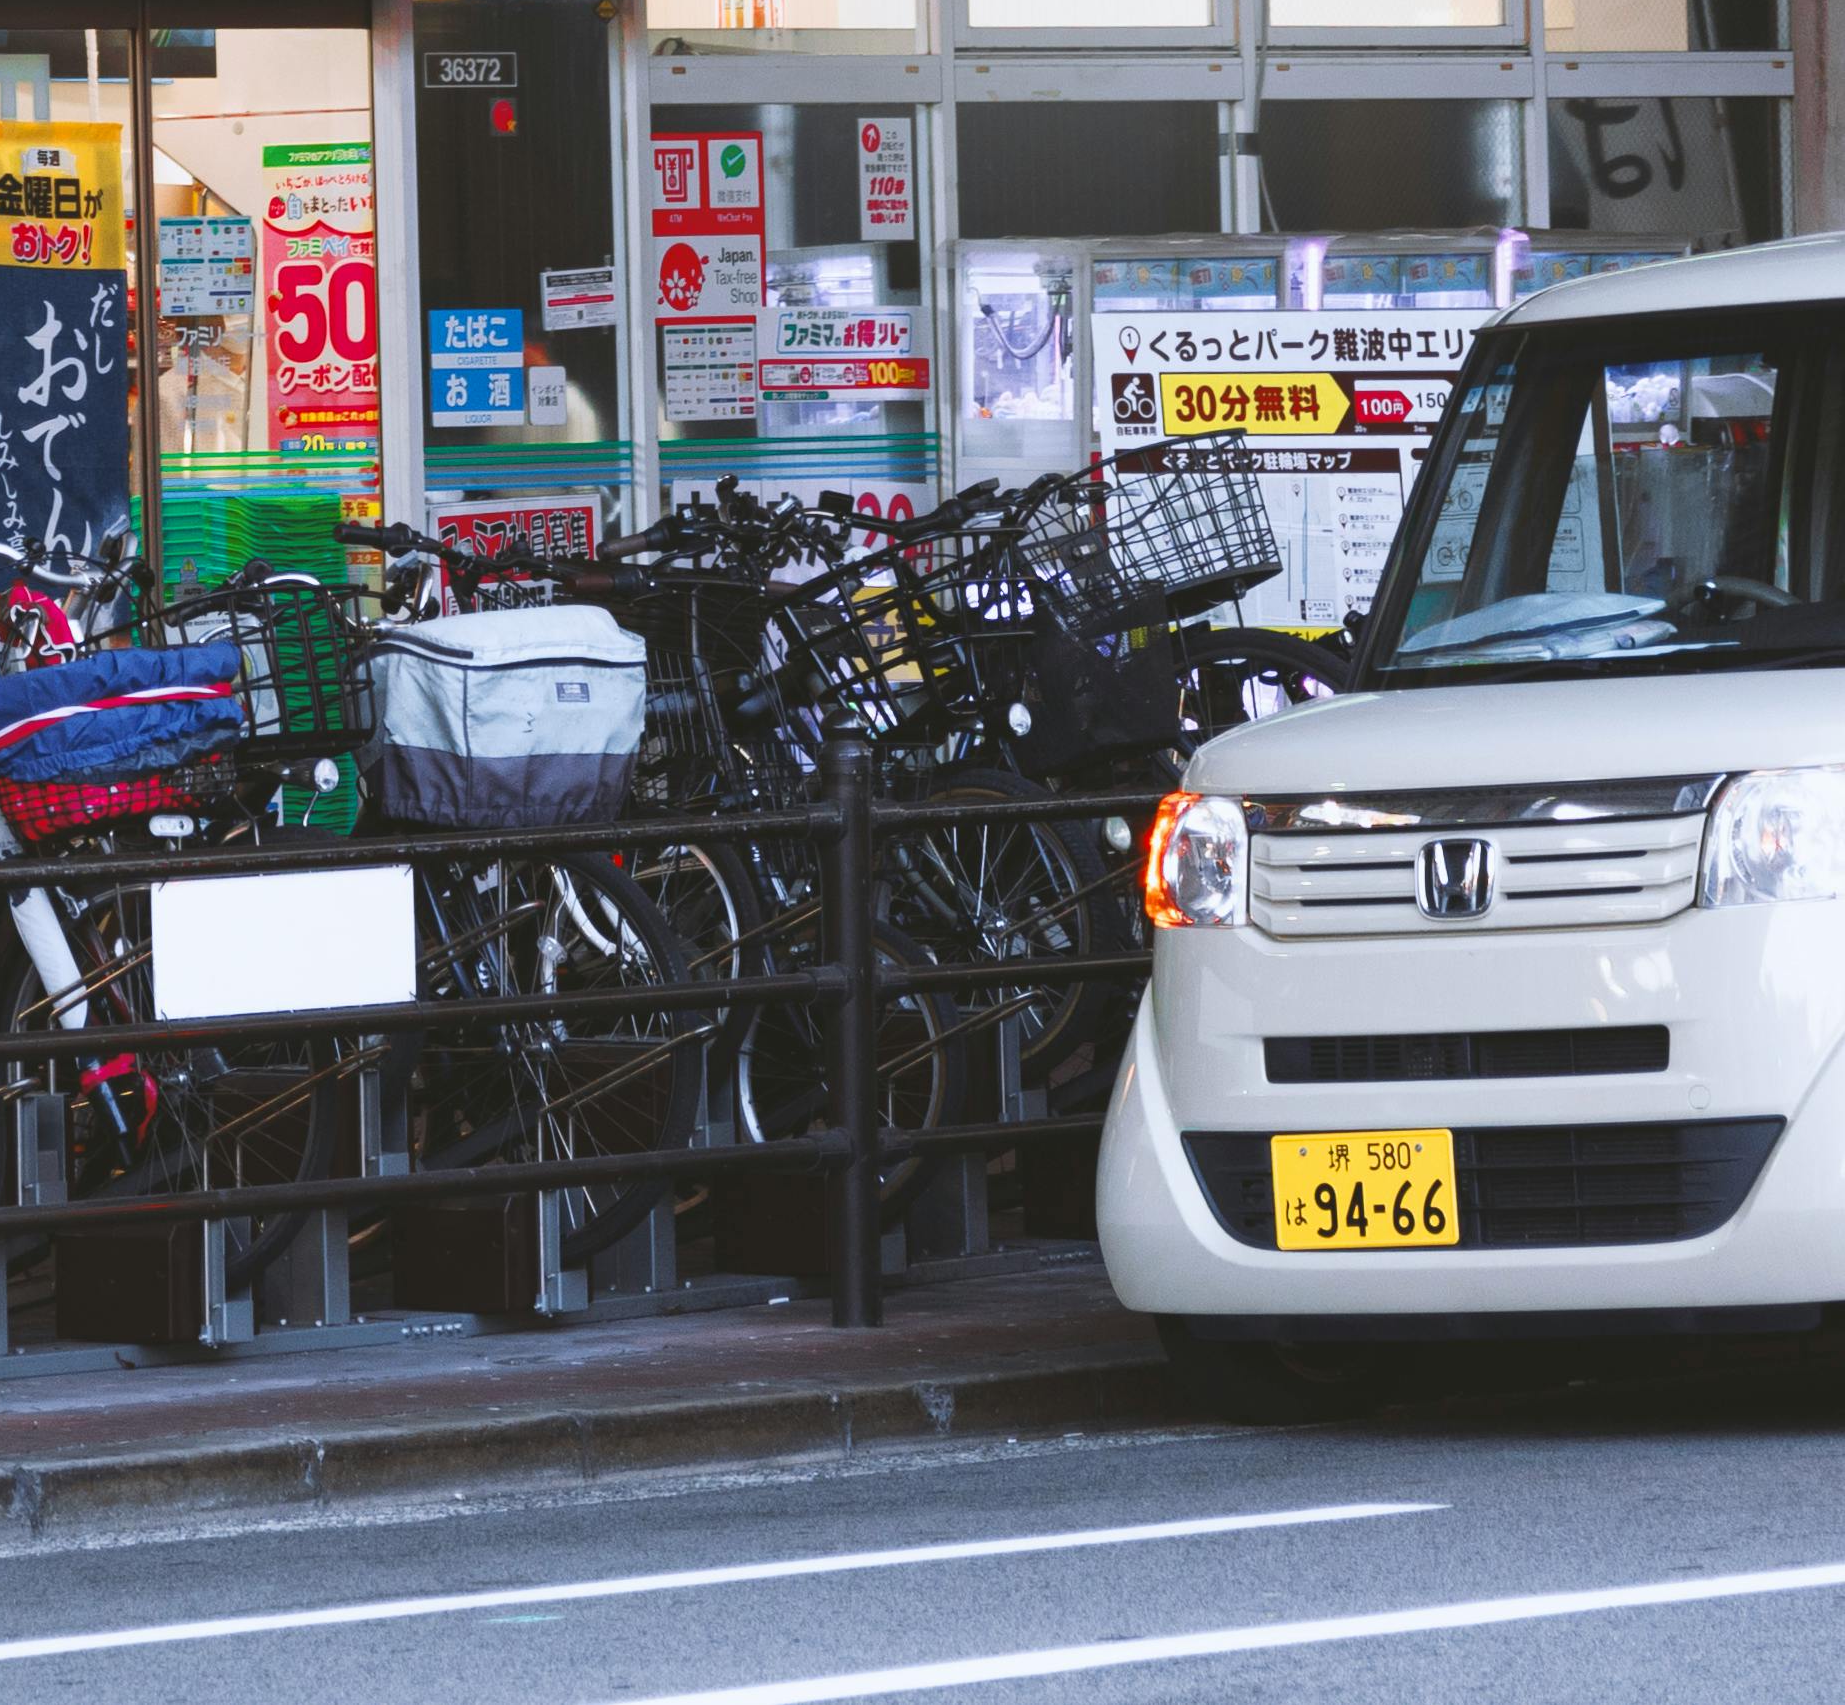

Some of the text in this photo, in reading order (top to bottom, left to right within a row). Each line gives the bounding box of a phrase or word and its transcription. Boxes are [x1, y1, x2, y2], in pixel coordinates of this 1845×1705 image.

[440, 58, 501, 82] 36372
[36, 150, 60, 167] 毎週
[287, 238, 374, 257] ファミペイで対
[718, 247, 757, 266] Japan.
[714, 269, 758, 285] Tax-free
[730, 288, 758, 306] Shop
[90, 283, 118, 375] だし
[445, 315, 508, 348] たばこ
[1175, 385, 1320, 422] 30分無料
[1361, 398, 1404, 416] 100円
[18, 300, 92, 571] おでん
[1329, 1142, 1411, 1172] 堺 580
[1286, 1179, 1446, 1238] は 94-66
